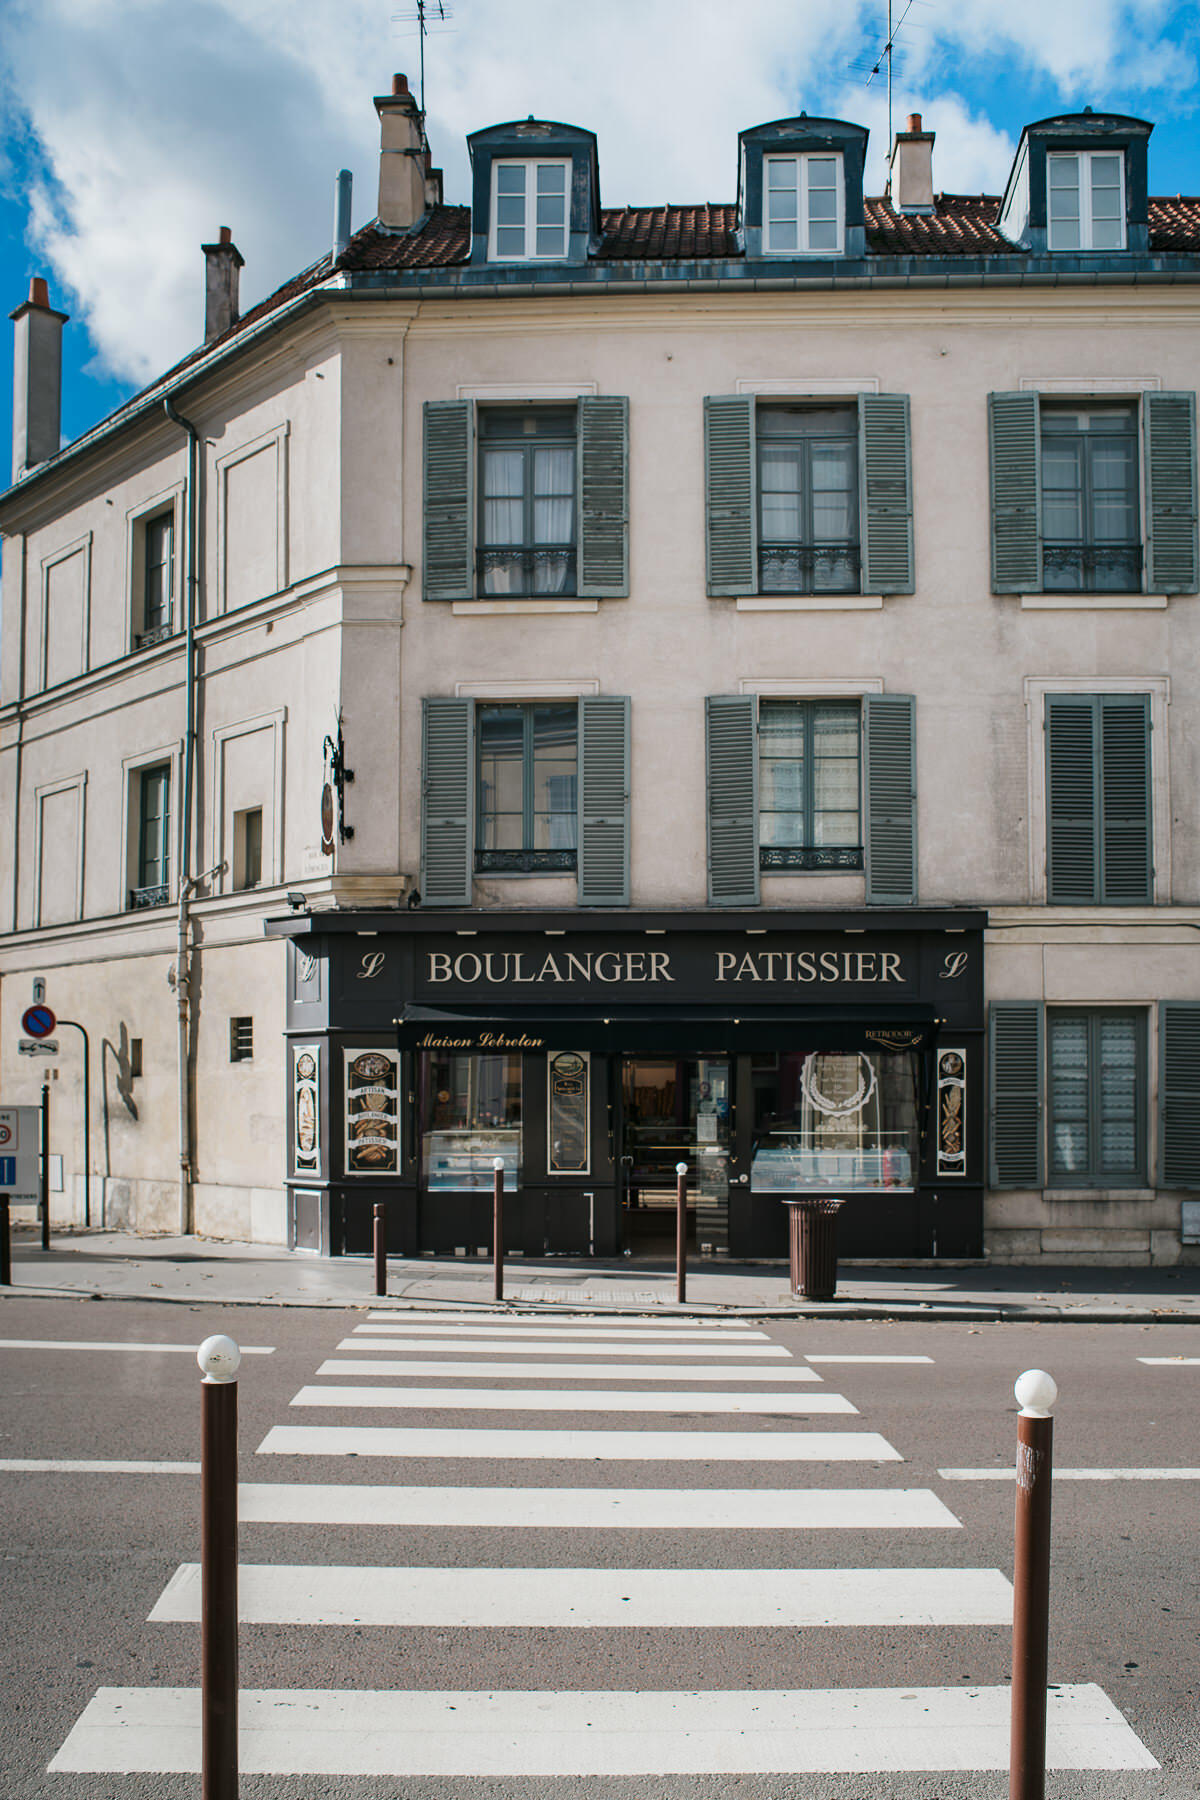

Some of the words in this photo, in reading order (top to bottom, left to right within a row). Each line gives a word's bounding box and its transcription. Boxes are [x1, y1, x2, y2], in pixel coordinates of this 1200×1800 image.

[357, 952, 386, 978] L
[428, 951, 675, 983] BOULANGER
[715, 951, 906, 983] PATISSIER
[939, 952, 968, 978] L
[416, 1032, 472, 1048] Maison
[476, 1031, 545, 1048] Lebreton
